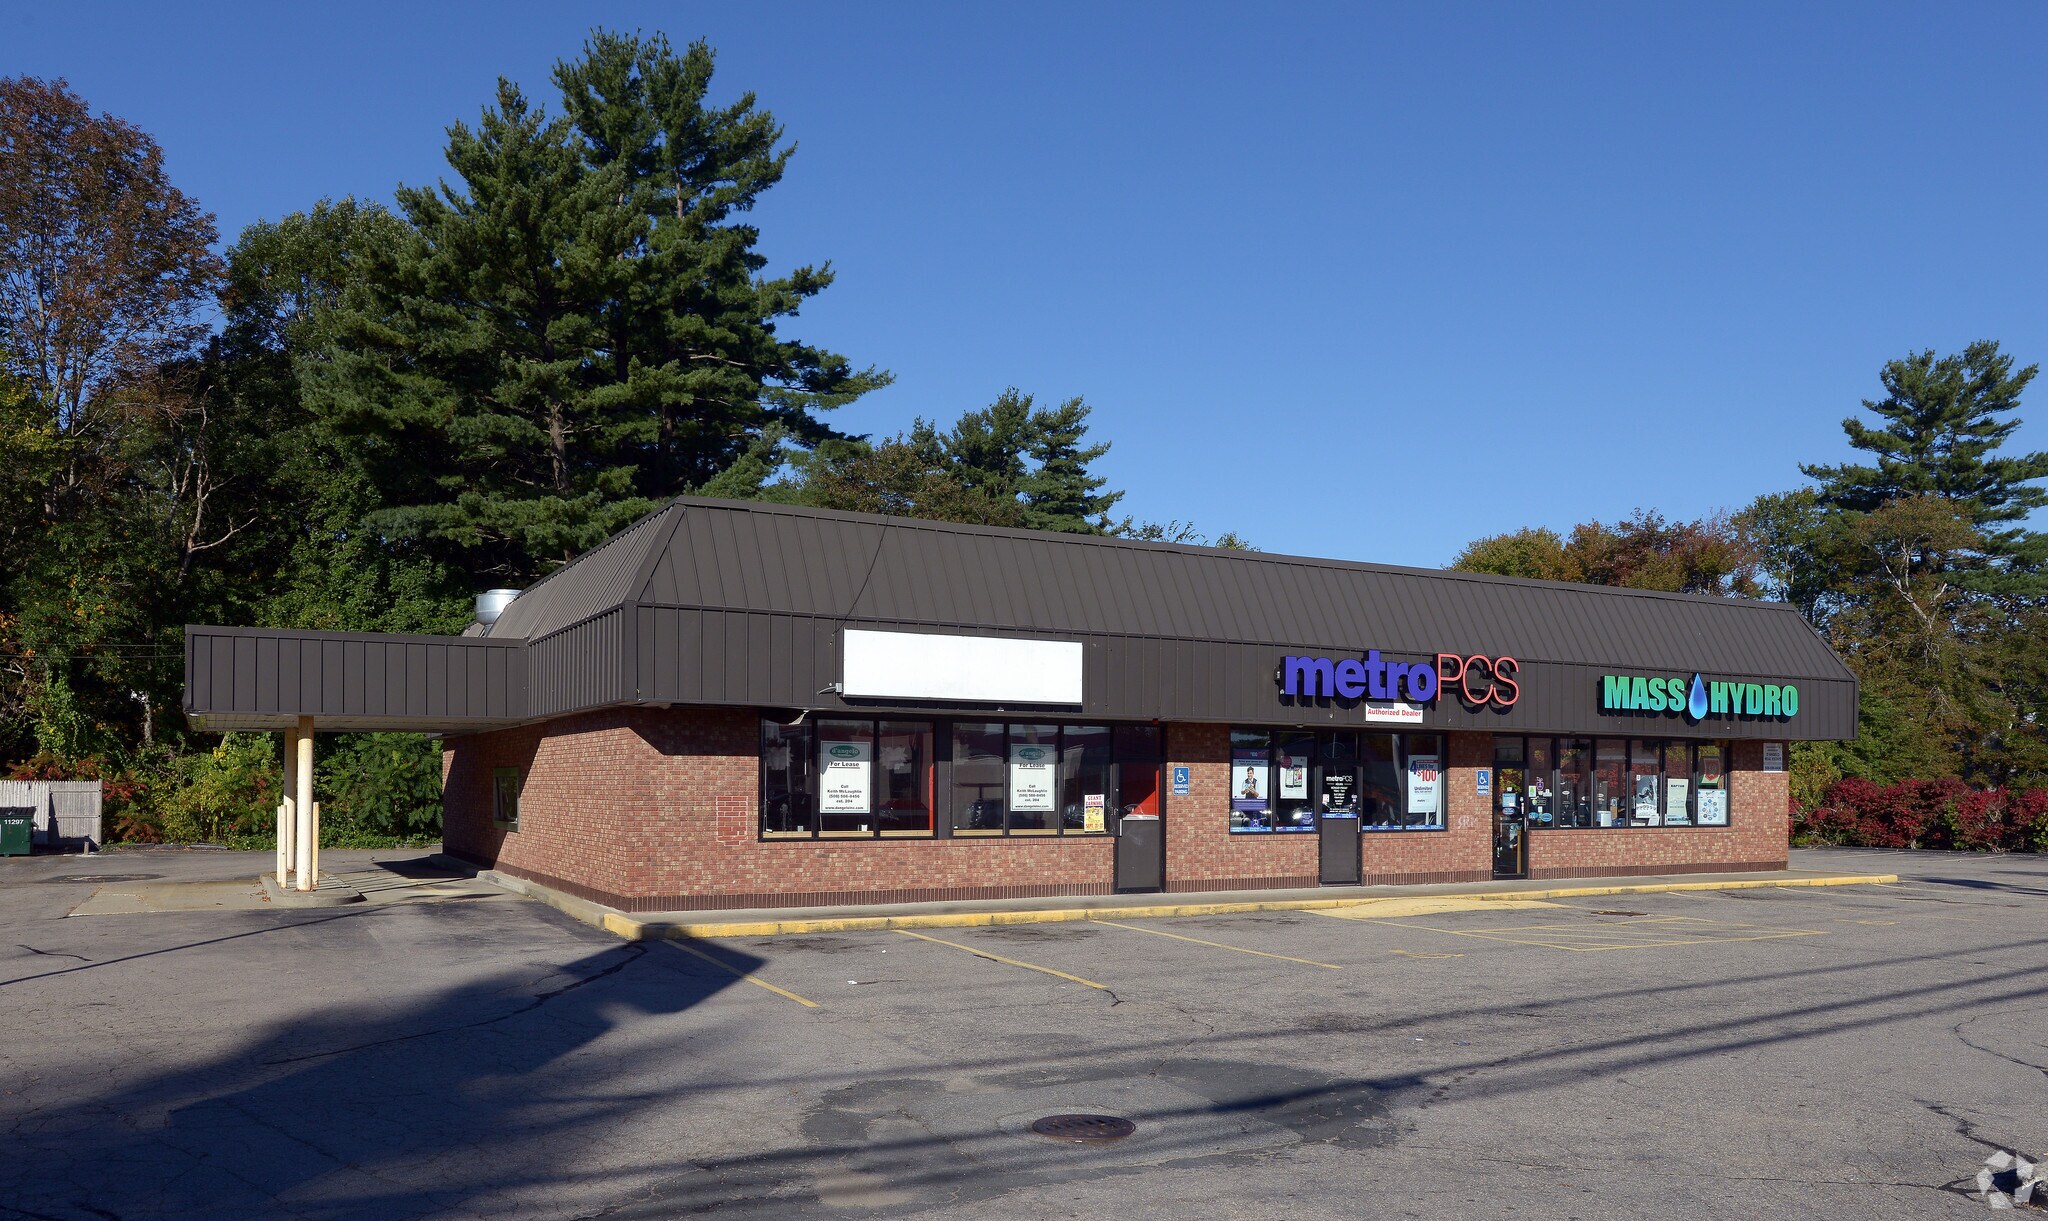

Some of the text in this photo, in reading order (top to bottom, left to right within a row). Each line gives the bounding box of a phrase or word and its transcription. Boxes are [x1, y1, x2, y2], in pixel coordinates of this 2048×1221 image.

[1284, 649, 1520, 706] metroPCS
[1604, 675, 1799, 717] MASS HYDRO
[1367, 708, 1422, 718] Authorized Dealer
[1410, 760, 1417, 775] 4
[1417, 769, 1437, 781] $100
